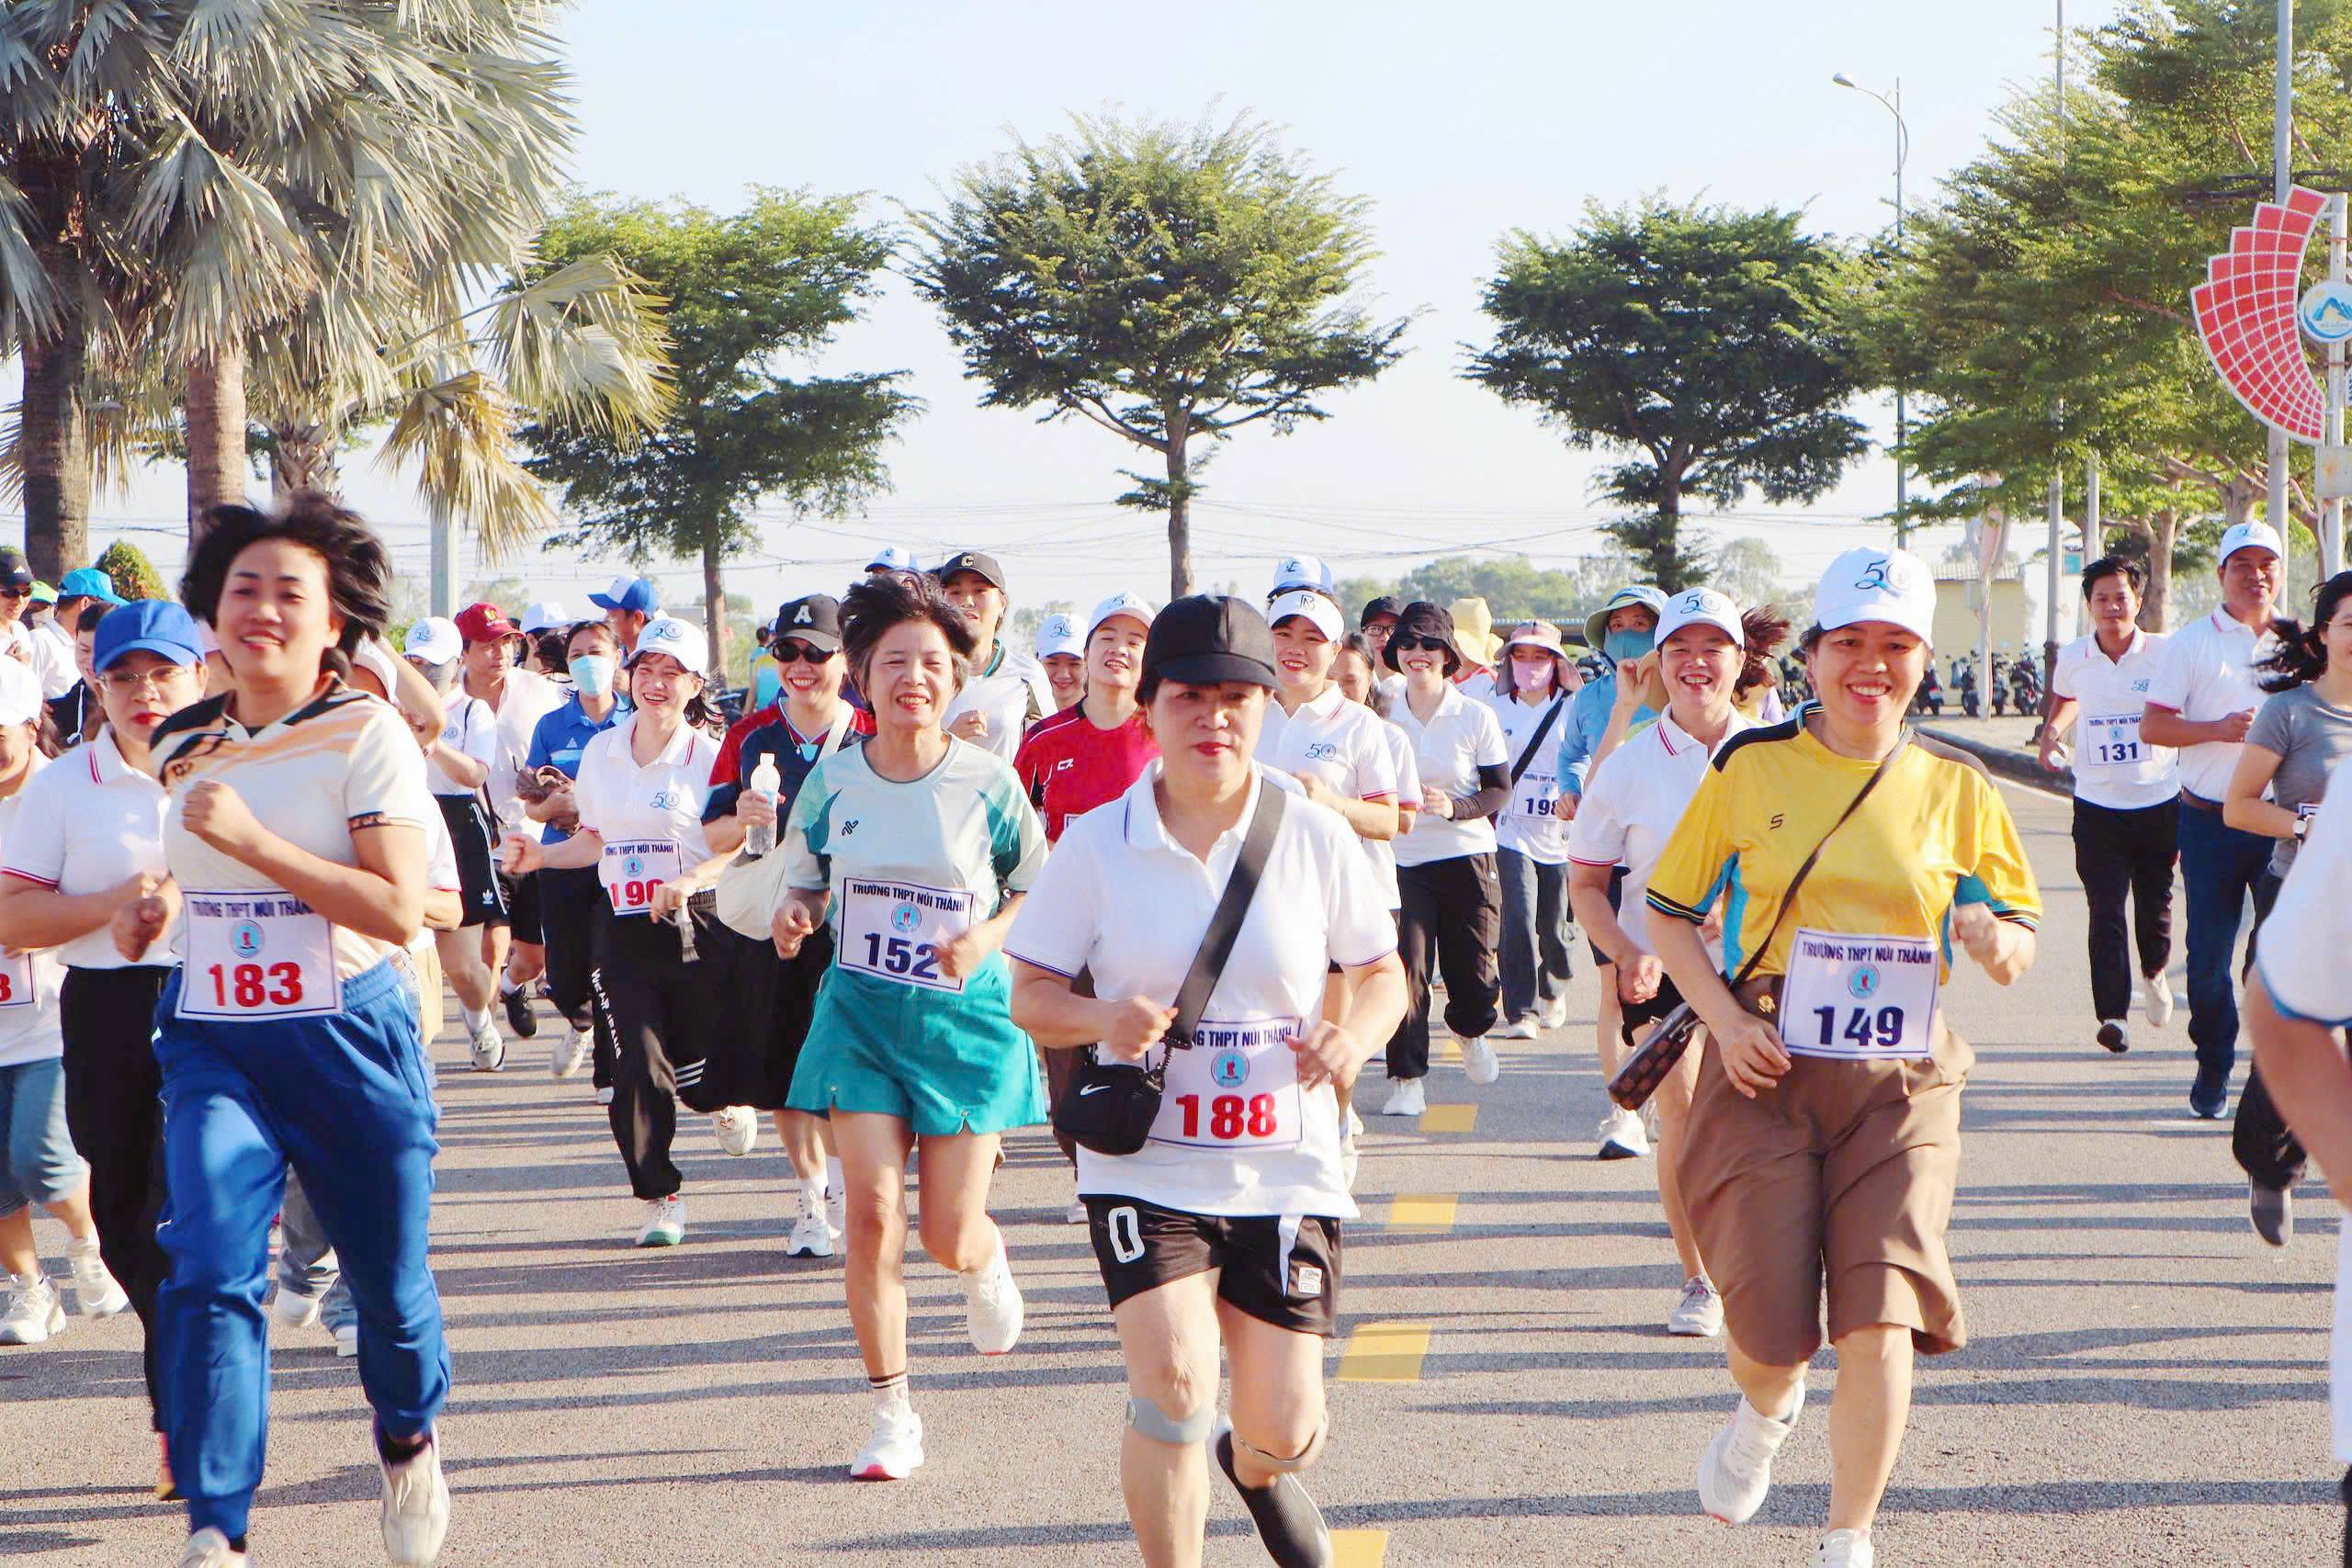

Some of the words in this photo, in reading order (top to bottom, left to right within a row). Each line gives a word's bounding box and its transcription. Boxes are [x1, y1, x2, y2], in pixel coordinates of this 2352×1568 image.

[794, 605, 812, 624] A
[1305, 743, 1337, 761] 50
[2098, 742, 2138, 761] 131
[619, 845, 635, 855] THPT
[853, 883, 890, 897] TRƯỜNG
[893, 887, 915, 902] THPT
[917, 892, 932, 908] NÚI
[935, 894, 965, 912] THÀNH
[865, 932, 938, 980] 152
[1848, 946, 1872, 962] THPT
[207, 962, 303, 1008] 183
[1813, 1006, 1905, 1047] 149
[1209, 1030, 1238, 1047] THPT
[1176, 1092, 1277, 1140] 188
